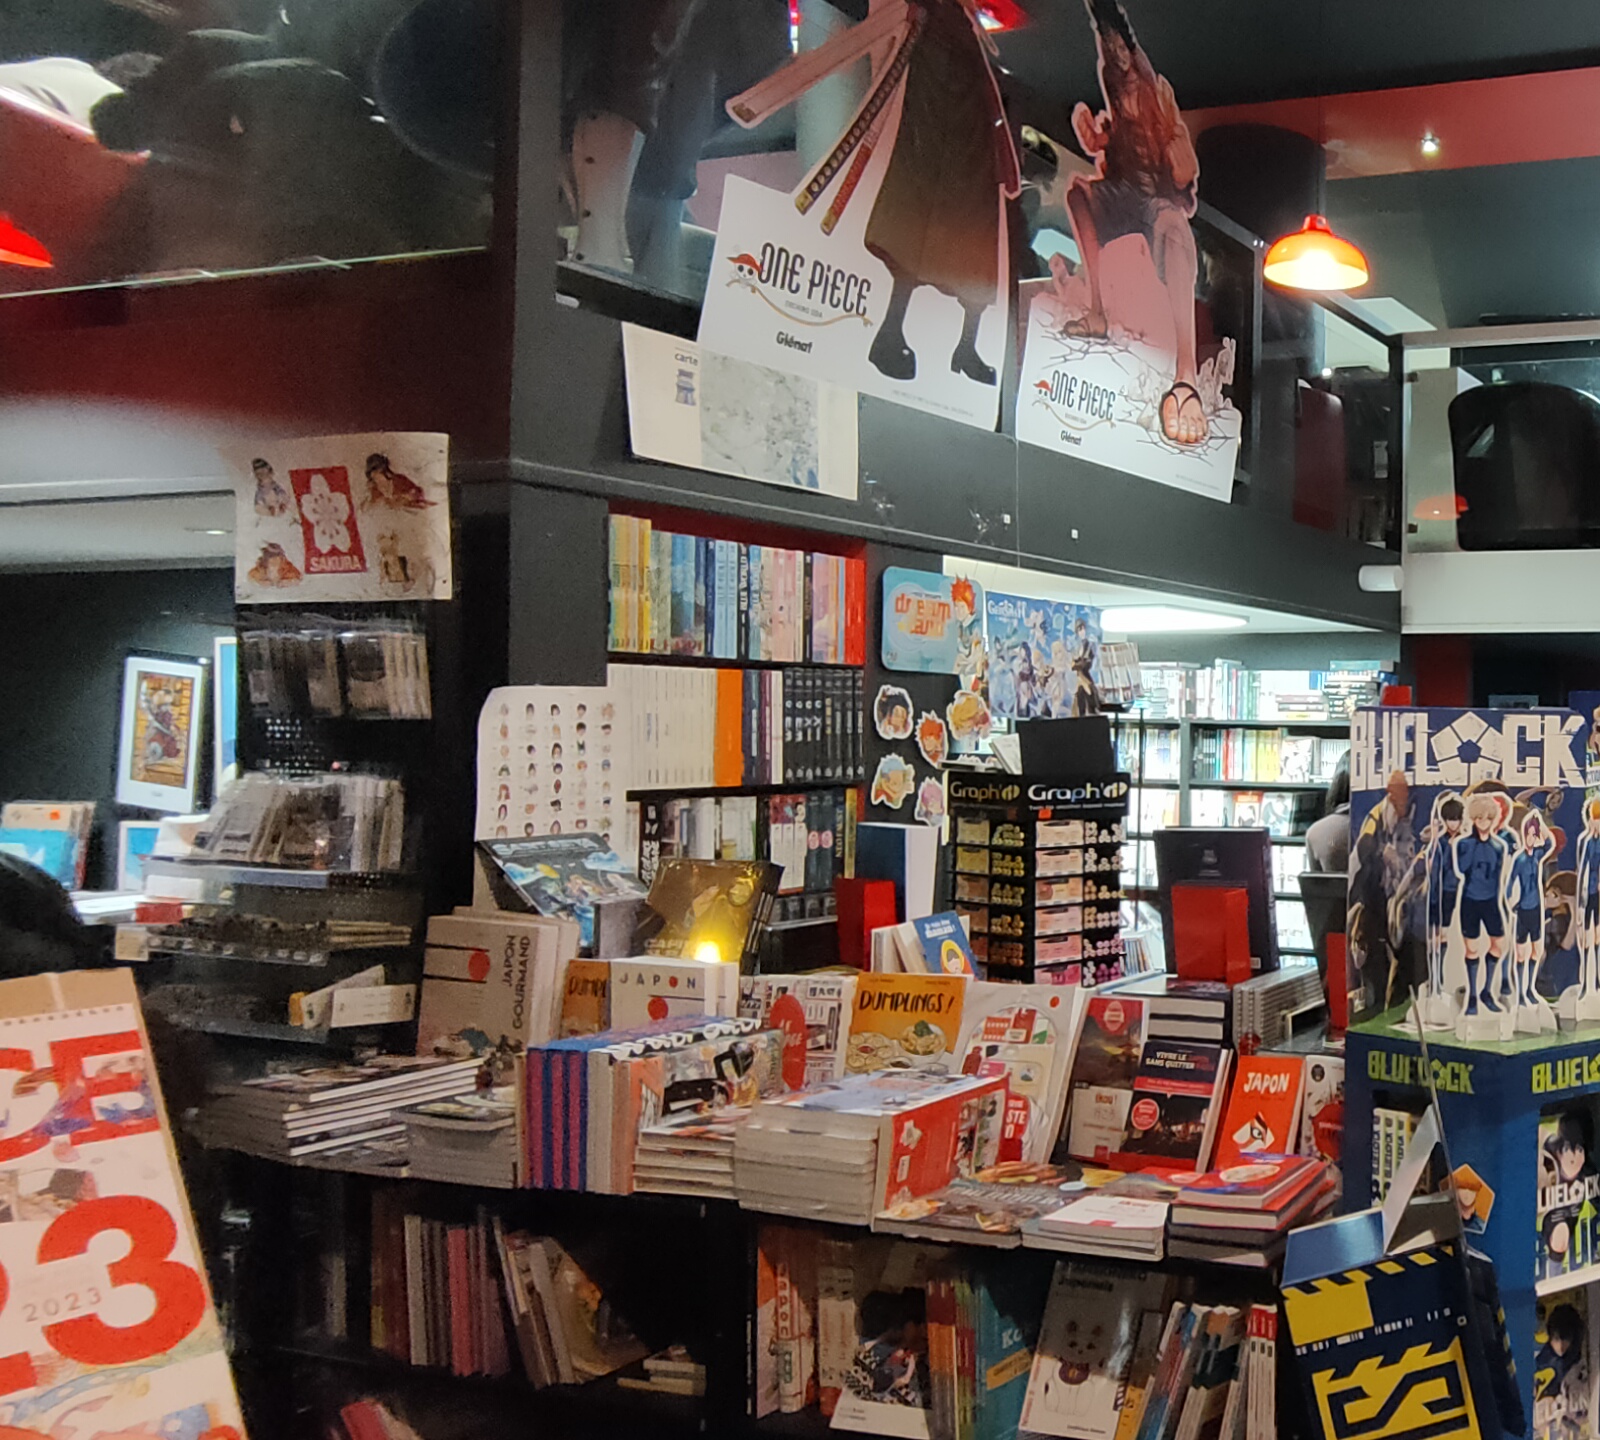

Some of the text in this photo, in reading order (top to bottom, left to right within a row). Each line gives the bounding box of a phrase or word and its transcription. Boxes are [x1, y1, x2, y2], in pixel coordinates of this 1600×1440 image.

[758, 242, 871, 317] ONE PIECE
[776, 331, 813, 354] Glénat
[1050, 370, 1116, 421] ONE PIECE
[310, 555, 362, 571] SAKURA
[502, 935, 517, 987] JAPON
[512, 936, 531, 1030] GOURMAND
[859, 990, 944, 1014] DUMPLINGS
[1243, 1072, 1290, 1093] JAPON
[22, 1287, 102, 1323] 2023
